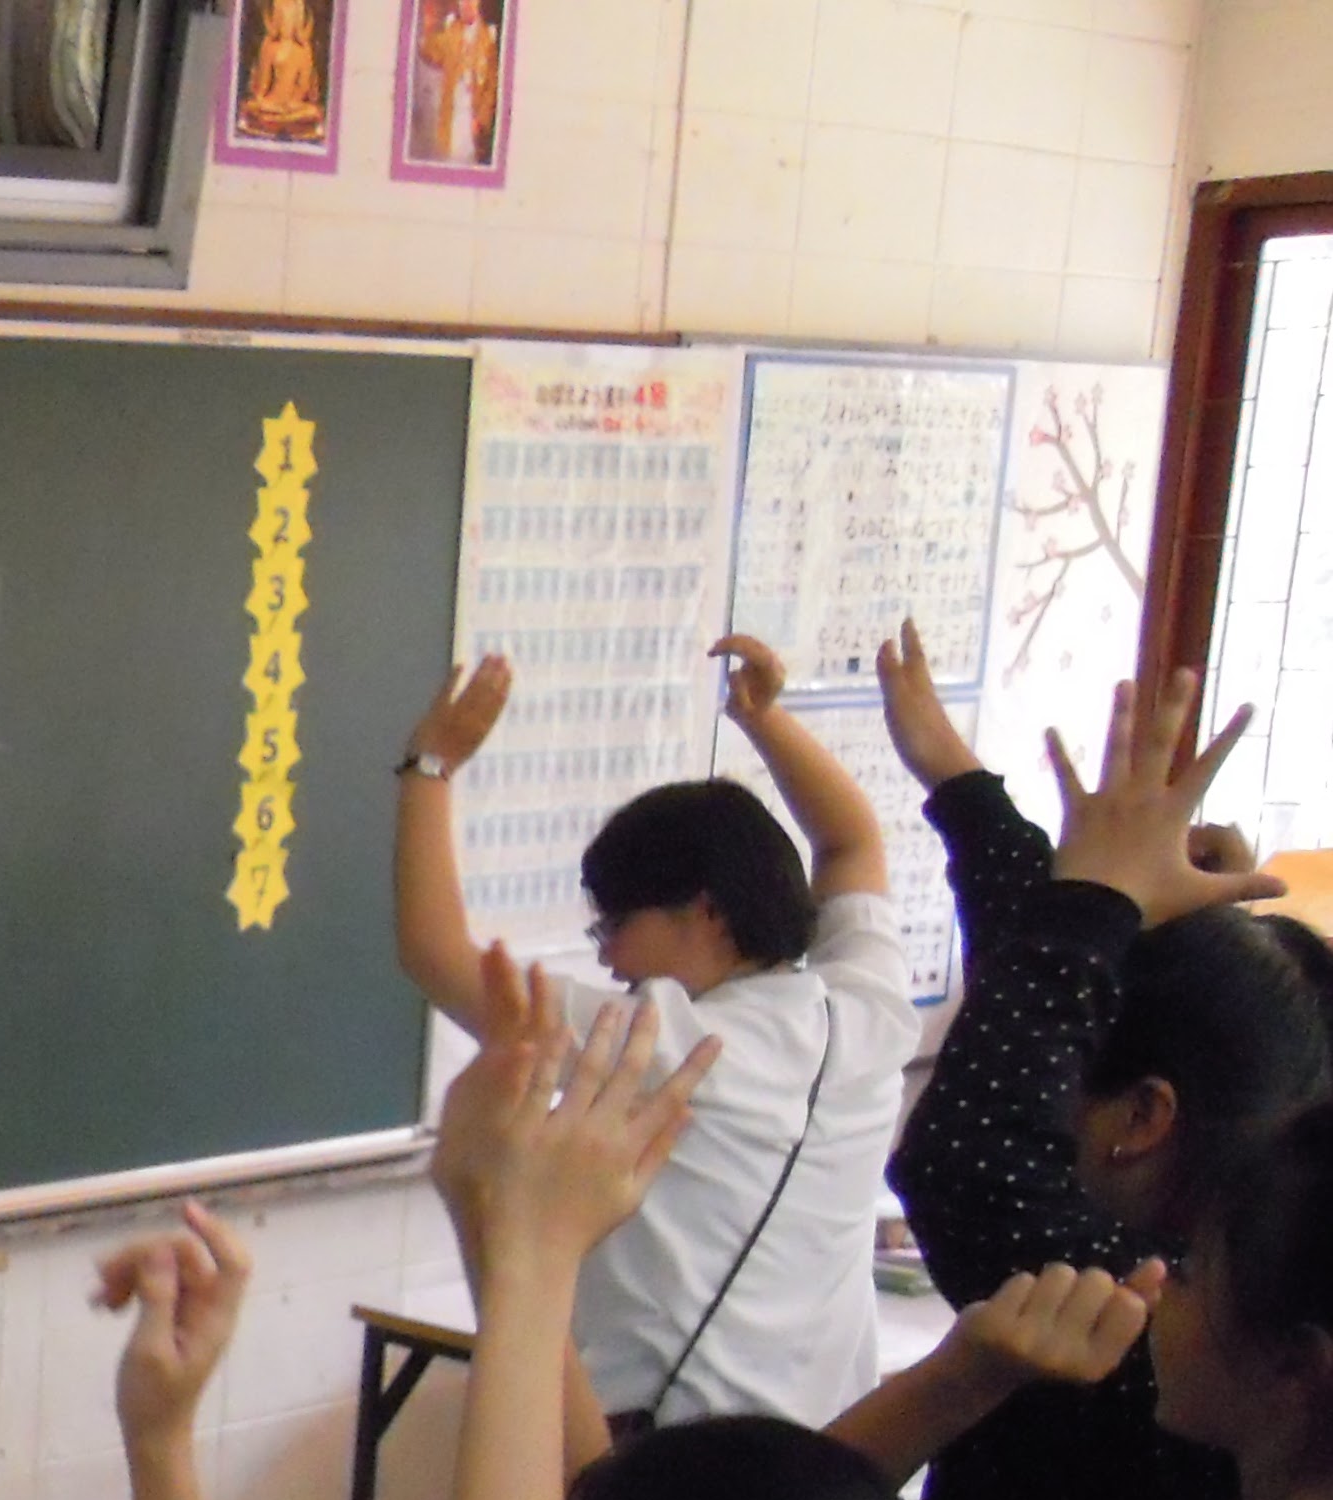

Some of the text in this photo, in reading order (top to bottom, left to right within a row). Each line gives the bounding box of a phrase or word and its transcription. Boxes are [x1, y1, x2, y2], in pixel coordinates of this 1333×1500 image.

[278, 434, 294, 472] 1
[273, 507, 290, 543] 2
[266, 575, 285, 610] 3
[263, 650, 282, 685] 4
[262, 728, 279, 763] 5
[256, 795, 275, 831] 6
[250, 864, 270, 900] 7
